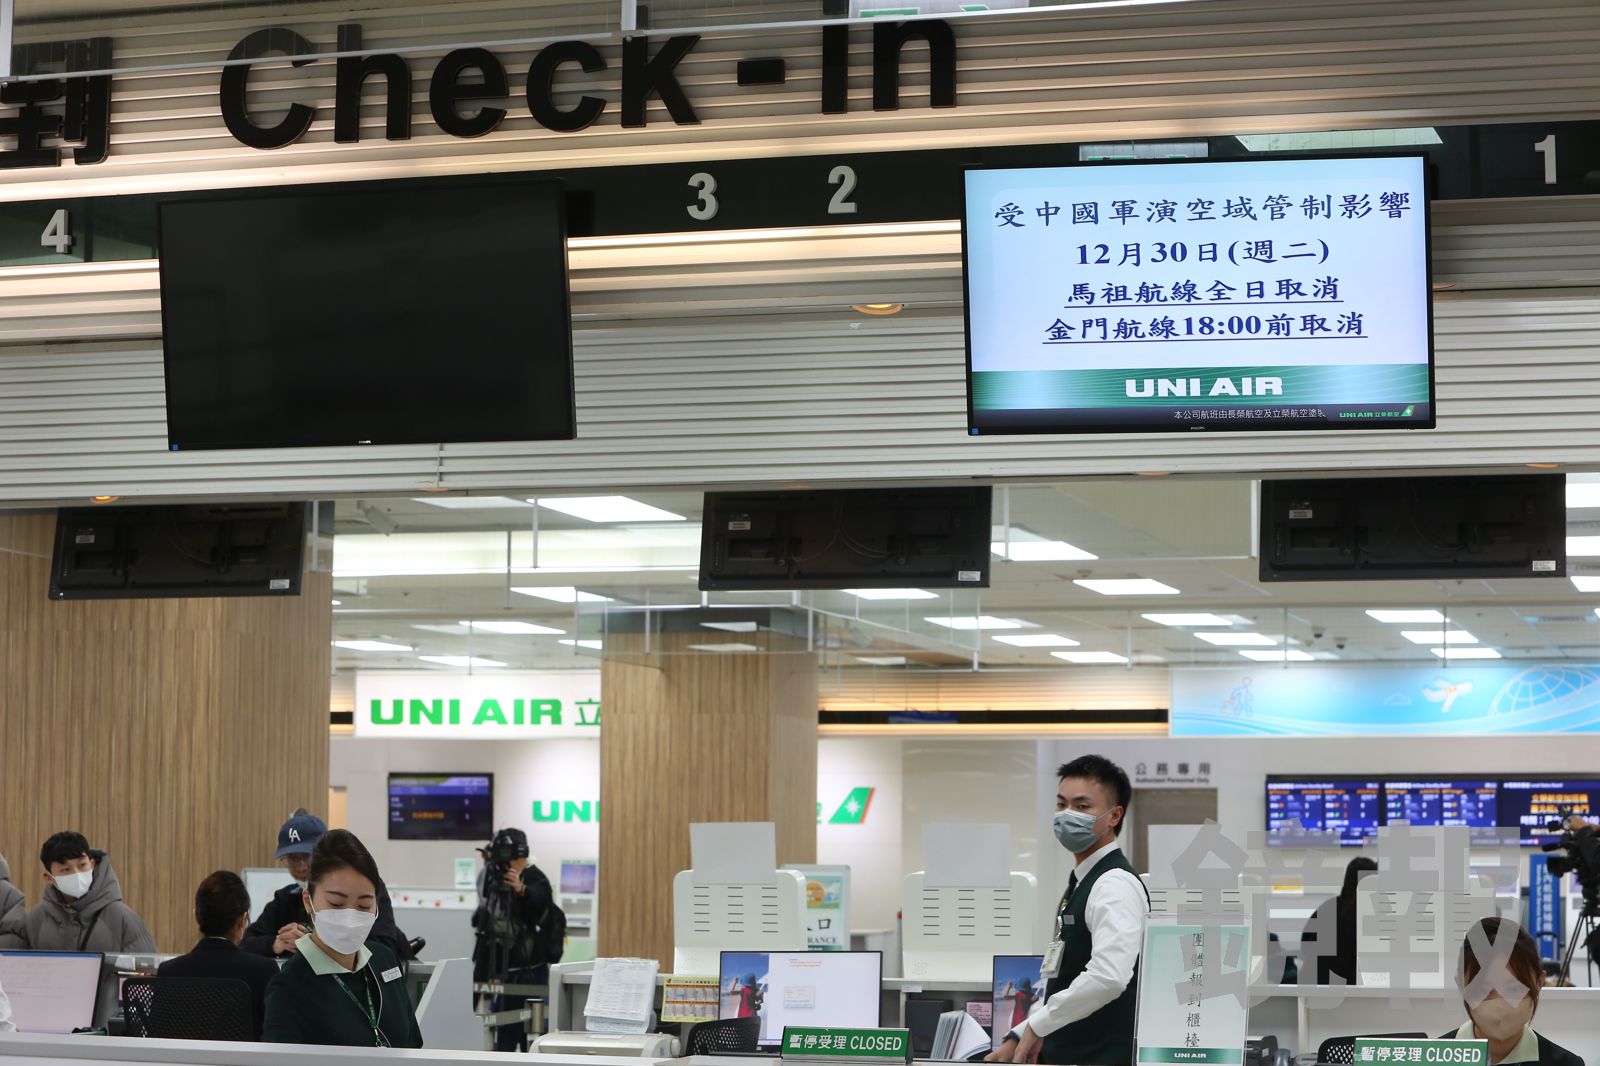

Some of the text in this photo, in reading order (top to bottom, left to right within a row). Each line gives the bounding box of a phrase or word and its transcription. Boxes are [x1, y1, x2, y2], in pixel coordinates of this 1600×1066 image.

[1534, 134, 1557, 184] 1
[686, 172, 719, 220] 3
[828, 165, 857, 214] 2
[994, 191, 1412, 229] 受中國軍演空域管制影響
[41, 209, 72, 254] 4
[1075, 239, 1330, 267] 12月30日(週二)
[1067, 275, 1340, 304] 馬祖航線全日取消
[1044, 311, 1365, 342] 金門航線18:00前取消
[1125, 376, 1284, 398] UNI AIR
[371, 698, 601, 726] UNI AIR 立
[289, 828, 301, 842] LA
[808, 936, 836, 944] RANCE
[520, 1009, 532, 1020] UN
[789, 1034, 902, 1051] 暫停受理 CLOSED
[1361, 1046, 1481, 1063] 暫停受理 CLOSED
